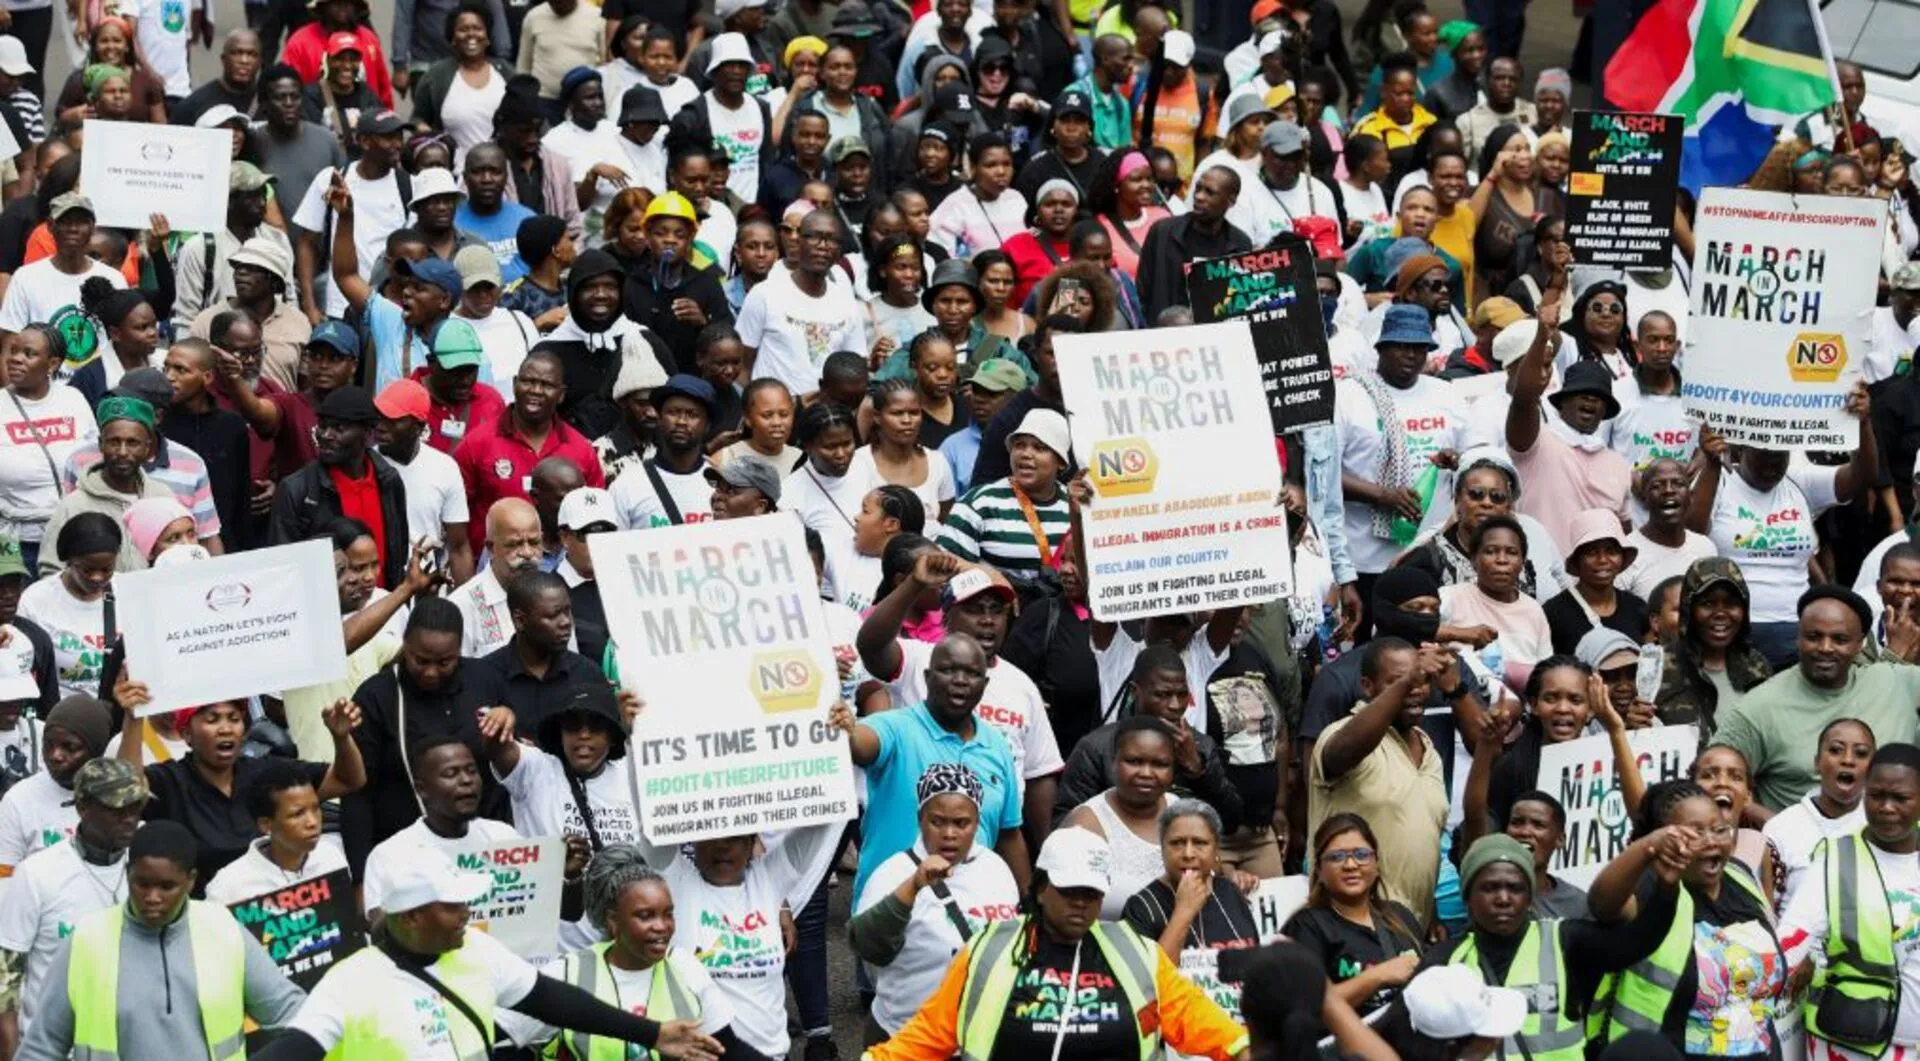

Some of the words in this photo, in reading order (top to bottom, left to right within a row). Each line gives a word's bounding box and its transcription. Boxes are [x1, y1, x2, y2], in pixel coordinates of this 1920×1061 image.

[1591, 115, 1666, 132] MARCH
[1607, 132, 1649, 147] AND
[1589, 147, 1664, 164] MARCH
[1623, 201, 1649, 210] WHITE
[1704, 206, 1877, 227] #STOPHOMEAFFAIRSCORRUPTION
[1611, 213, 1622, 222] OR
[1625, 214, 1652, 224] GREEN
[1569, 225, 1582, 234] AN
[1584, 225, 1617, 236] ILLEGAL
[1615, 239, 1627, 249] AN
[1629, 240, 1661, 250] ILLEGAL
[1204, 249, 1291, 280] MARCH
[1706, 241, 1826, 284] MARCH
[1227, 272, 1276, 296] AND
[1757, 275, 1771, 290] IN
[1701, 282, 1821, 325] MARCH
[1253, 310, 1268, 323] WE
[1269, 308, 1288, 321] WIN
[1092, 345, 1225, 390] MARCH
[1280, 354, 1318, 372] POWER
[1281, 370, 1331, 389] TRUSTED
[1273, 396, 1282, 408] A
[1284, 389, 1321, 406] CHECK
[1101, 389, 1234, 436] MARCH
[1685, 407, 1705, 420] JOIN
[1709, 412, 1722, 422] US
[1726, 413, 1737, 425] IN
[1740, 416, 1787, 430] FIGHTING
[1789, 418, 1829, 430] ILLEGAL
[1749, 433, 1771, 444] AND
[1775, 434, 1803, 444] THEIR
[1808, 435, 1845, 445] CRIMES
[1093, 534, 1139, 549] ILLEGAL
[1142, 524, 1215, 543] IMMIGRATION
[1219, 522, 1230, 533] IS
[1234, 521, 1243, 532] A
[1246, 515, 1281, 530] CRIME
[626, 537, 796, 598] MARCH
[1095, 560, 1146, 575] RECLAIM
[1149, 556, 1172, 568] OUR
[1175, 548, 1228, 565] COUNTRY
[1099, 584, 1125, 599] JOIN
[1129, 582, 1144, 595] US
[1147, 581, 1159, 593] IN
[1162, 574, 1215, 591] FIGHTING
[1219, 568, 1266, 584] ILLEGAL
[1101, 597, 1171, 615] IMMIGRANTS
[1176, 593, 1200, 606] AND
[1204, 589, 1239, 603] THEIR
[1244, 582, 1287, 598] CRIMES
[166, 631, 180, 642] AS
[183, 630, 191, 639] A
[193, 623, 234, 637] NATION
[641, 593, 809, 657] MARCH
[642, 737, 687, 766] IT'S
[696, 728, 757, 758] TIME
[766, 723, 799, 750] TO
[809, 719, 841, 744] GO
[645, 756, 840, 798] #DOIT4THEIRFUTURE
[652, 803, 679, 817] JOIN
[682, 800, 698, 814] US
[702, 798, 714, 811] IN
[718, 791, 773, 810] FIGHTING
[777, 785, 826, 802] ILLEGAL
[1607, 798, 1620, 817] IN
[653, 815, 729, 837] IMMIGRANTS
[733, 812, 758, 826] AND
[762, 806, 797, 821] THEIR
[802, 801, 847, 818] CRIMES
[457, 845, 540, 869] MARCH
[235, 879, 331, 923] MARCH
[489, 908, 505, 918] WE
[508, 906, 526, 916] WIN
[262, 908, 317, 940] AND
[1016, 1002, 1119, 1021] MARCH
